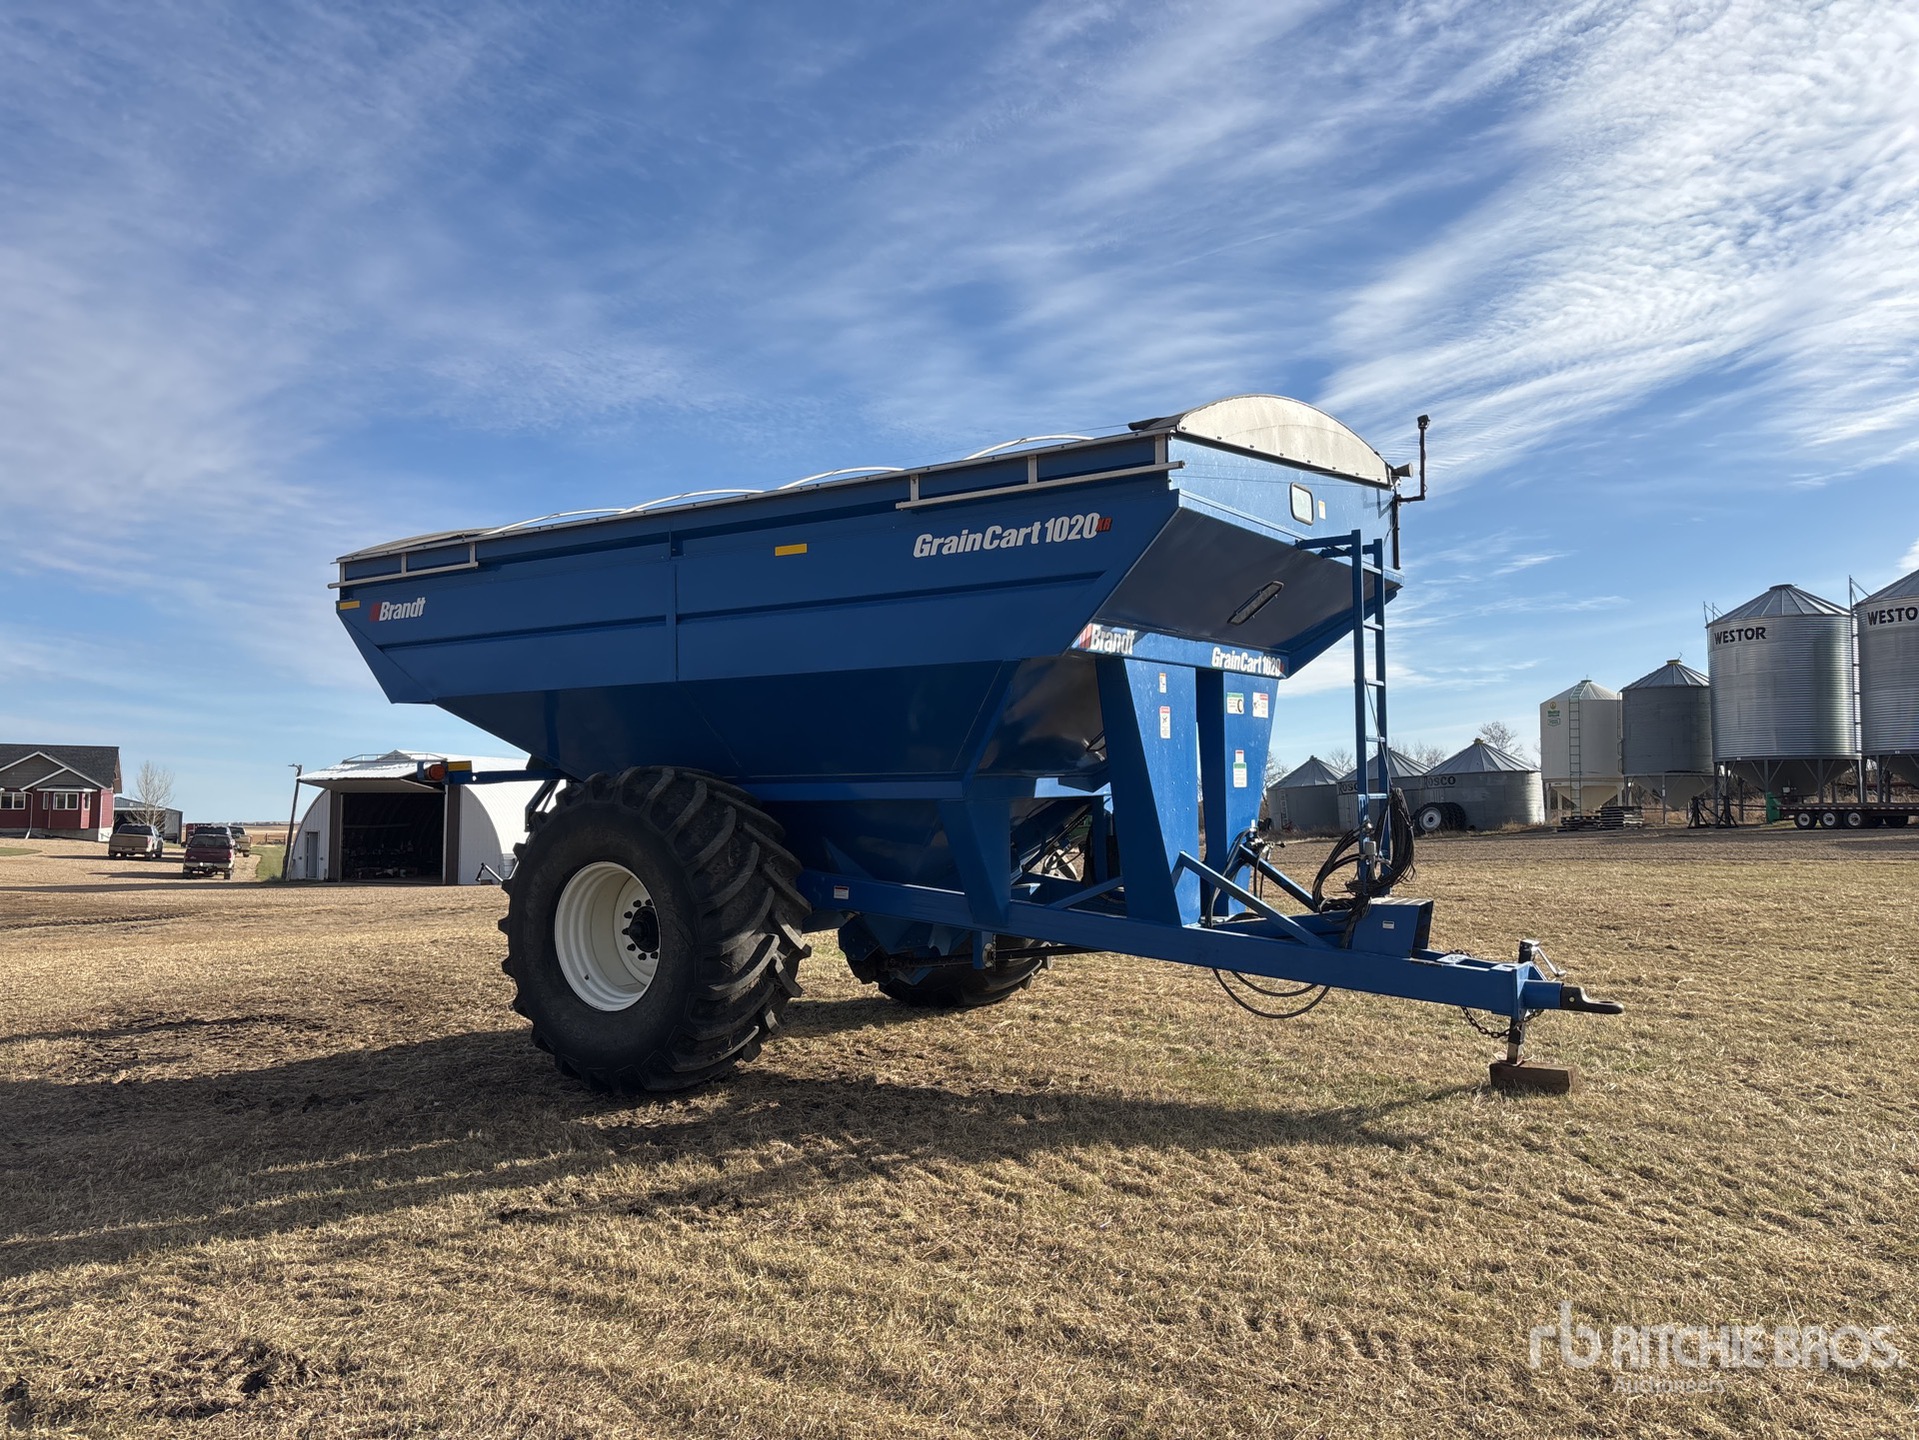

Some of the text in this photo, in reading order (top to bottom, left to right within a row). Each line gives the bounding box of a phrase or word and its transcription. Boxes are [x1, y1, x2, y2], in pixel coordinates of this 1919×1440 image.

[913, 521, 1043, 558] GrainCart
[379, 597, 426, 621] Brandt
[1867, 606, 1919, 626] WESTO
[1090, 623, 1135, 655] Brandt
[1714, 626, 1767, 645] WESTOR
[1211, 646, 1262, 673] GrainCart
[1424, 774, 1456, 790] ROSCO
